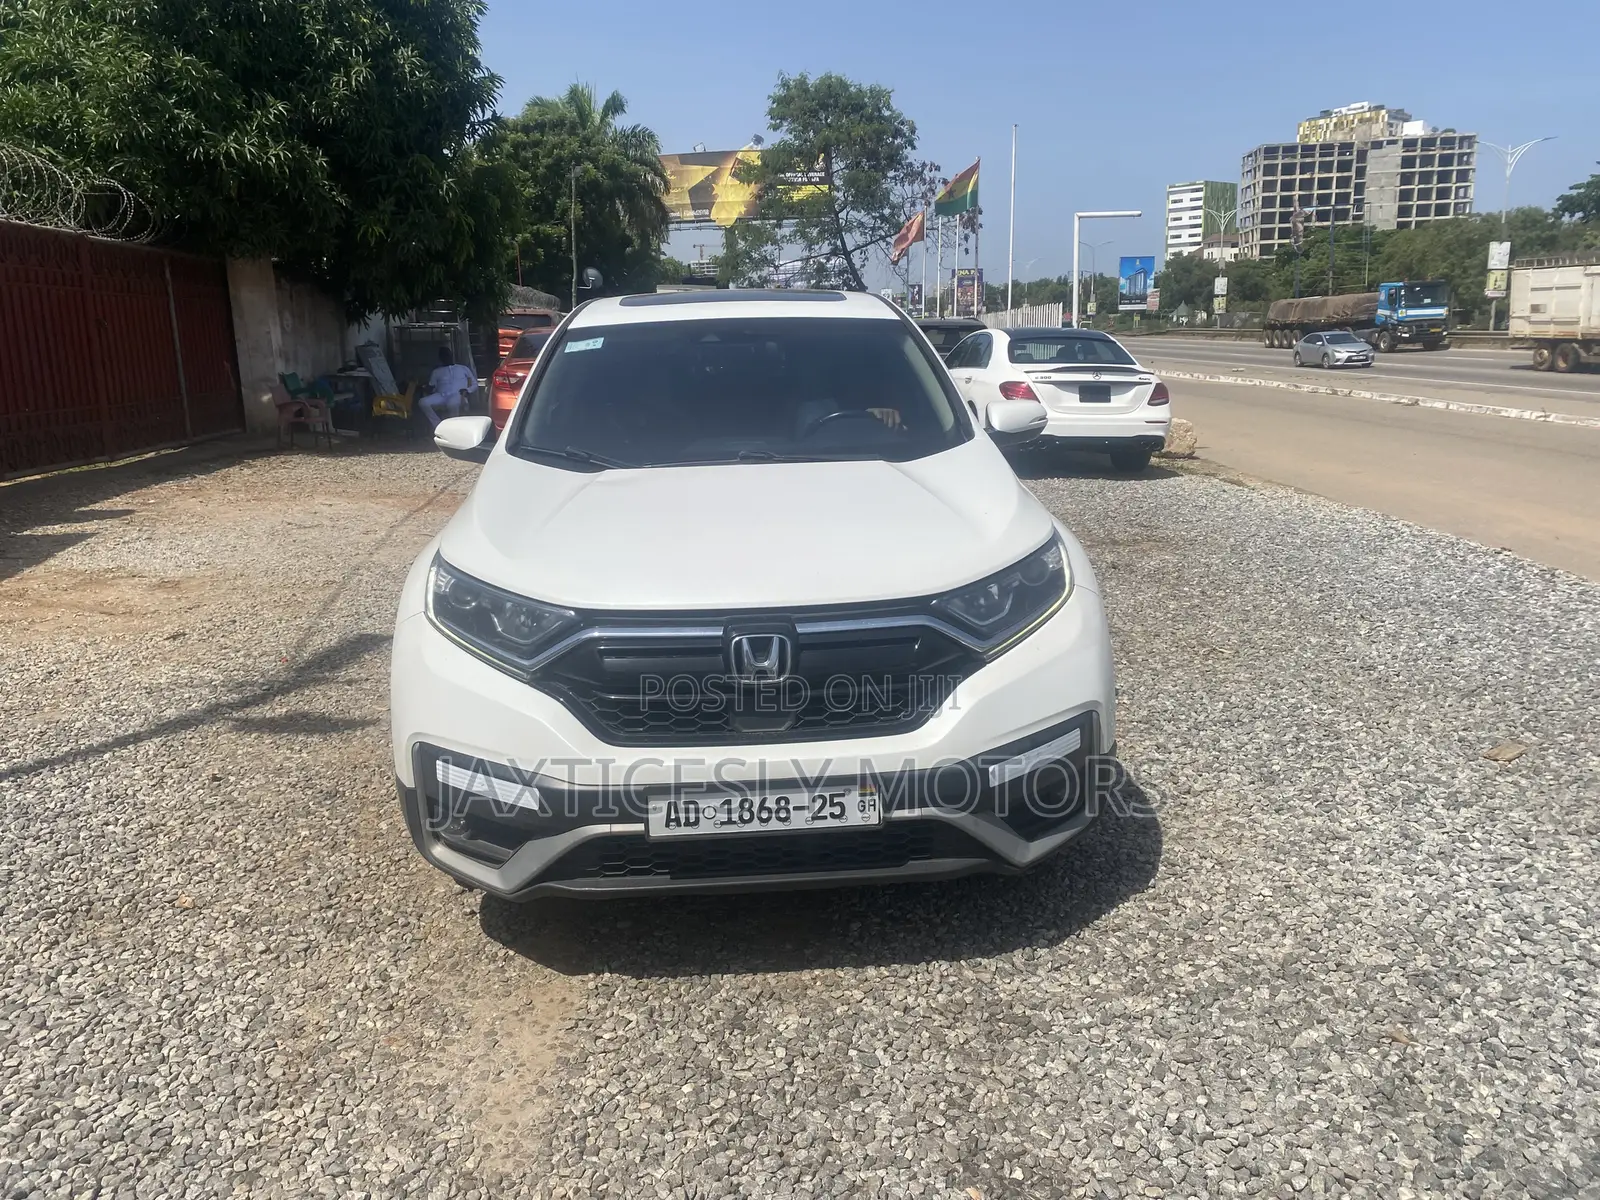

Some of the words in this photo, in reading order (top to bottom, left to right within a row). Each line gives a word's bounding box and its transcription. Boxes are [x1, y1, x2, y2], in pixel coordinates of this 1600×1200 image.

[664, 800, 700, 828] AD
[719, 794, 845, 824] 1868-25
[857, 798, 876, 813] GH
